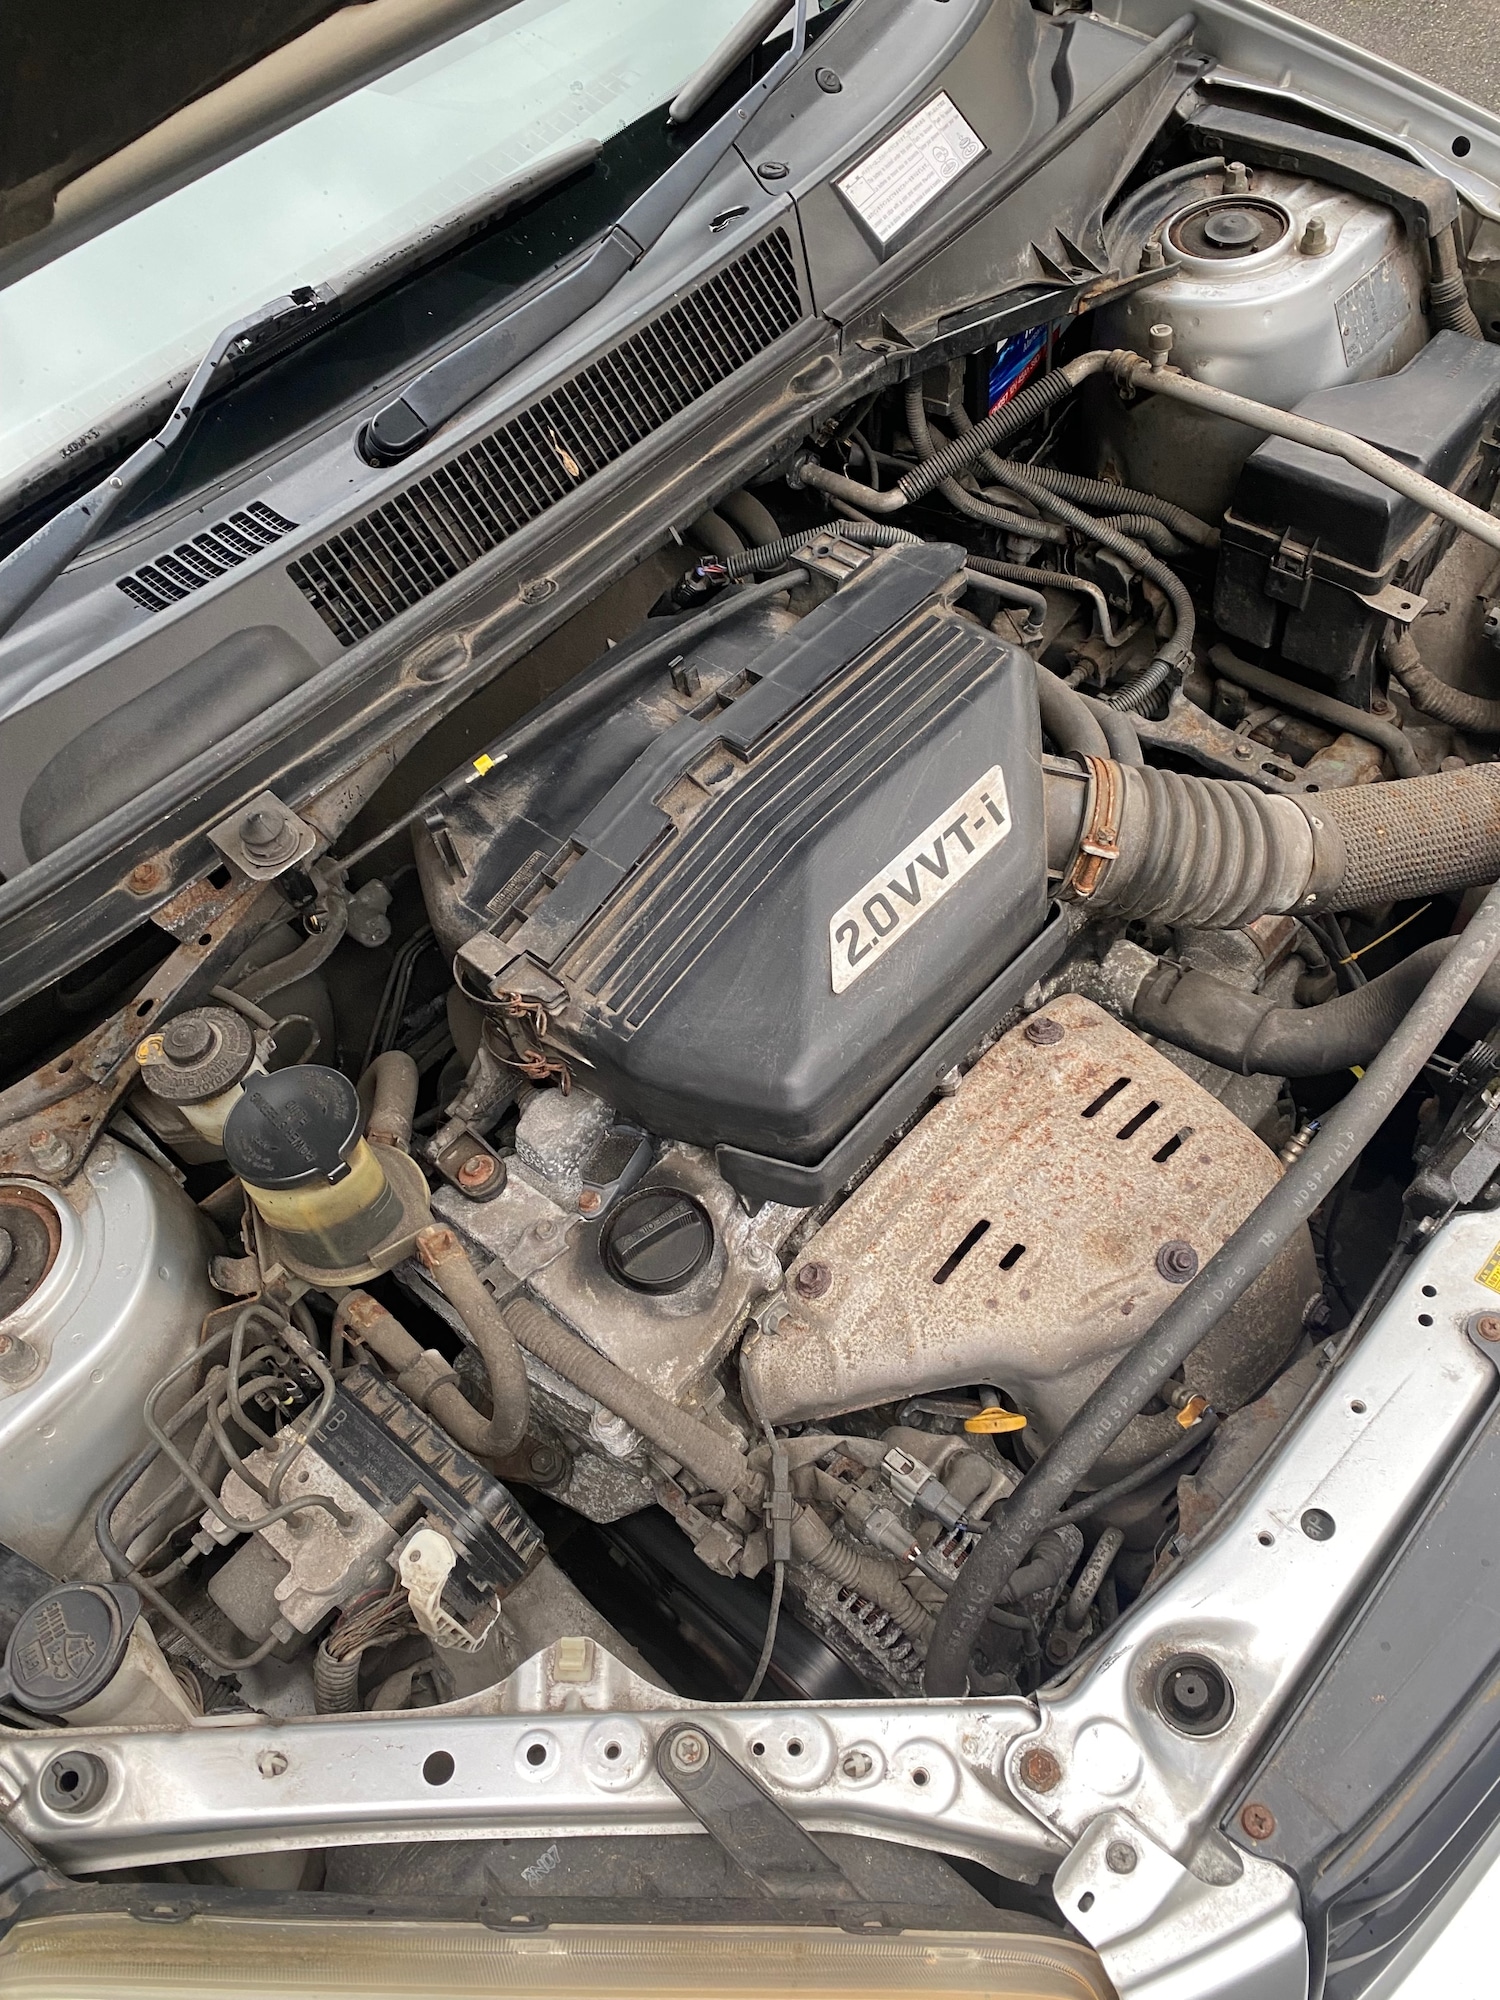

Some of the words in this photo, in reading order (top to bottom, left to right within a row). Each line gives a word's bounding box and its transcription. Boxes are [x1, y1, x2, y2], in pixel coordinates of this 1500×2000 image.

[250, 1092, 288, 1130] STEERING
[285, 1100, 308, 1126] FLUID
[283, 1129, 316, 1162] POWER
[657, 1202, 688, 1226] ENGINE
[641, 1222, 655, 1234] OIL
